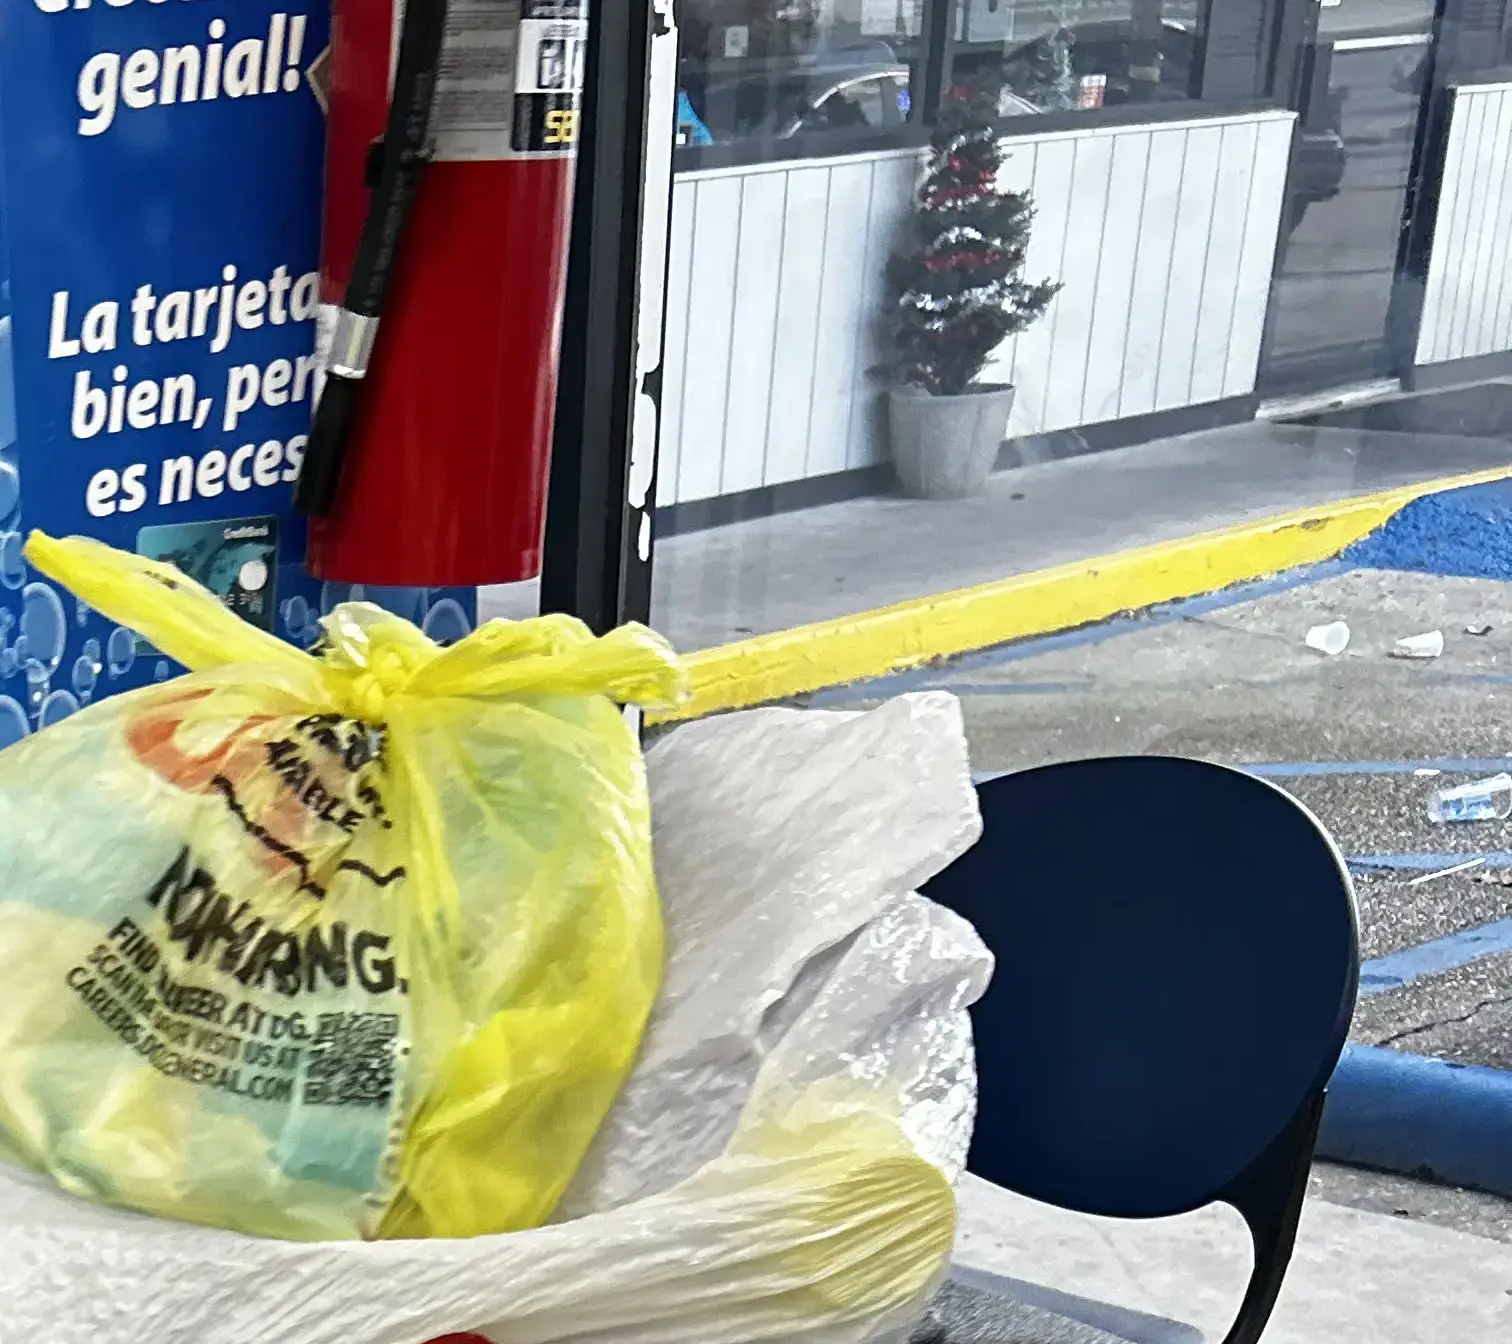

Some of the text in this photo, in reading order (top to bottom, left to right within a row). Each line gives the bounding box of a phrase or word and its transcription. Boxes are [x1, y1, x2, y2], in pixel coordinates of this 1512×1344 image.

[77, 13, 306, 136] genial!
[48, 264, 321, 359] La tarjeta
[71, 353, 318, 440] bien, per
[86, 434, 310, 517] es neces
[108, 916, 159, 974] FIND
